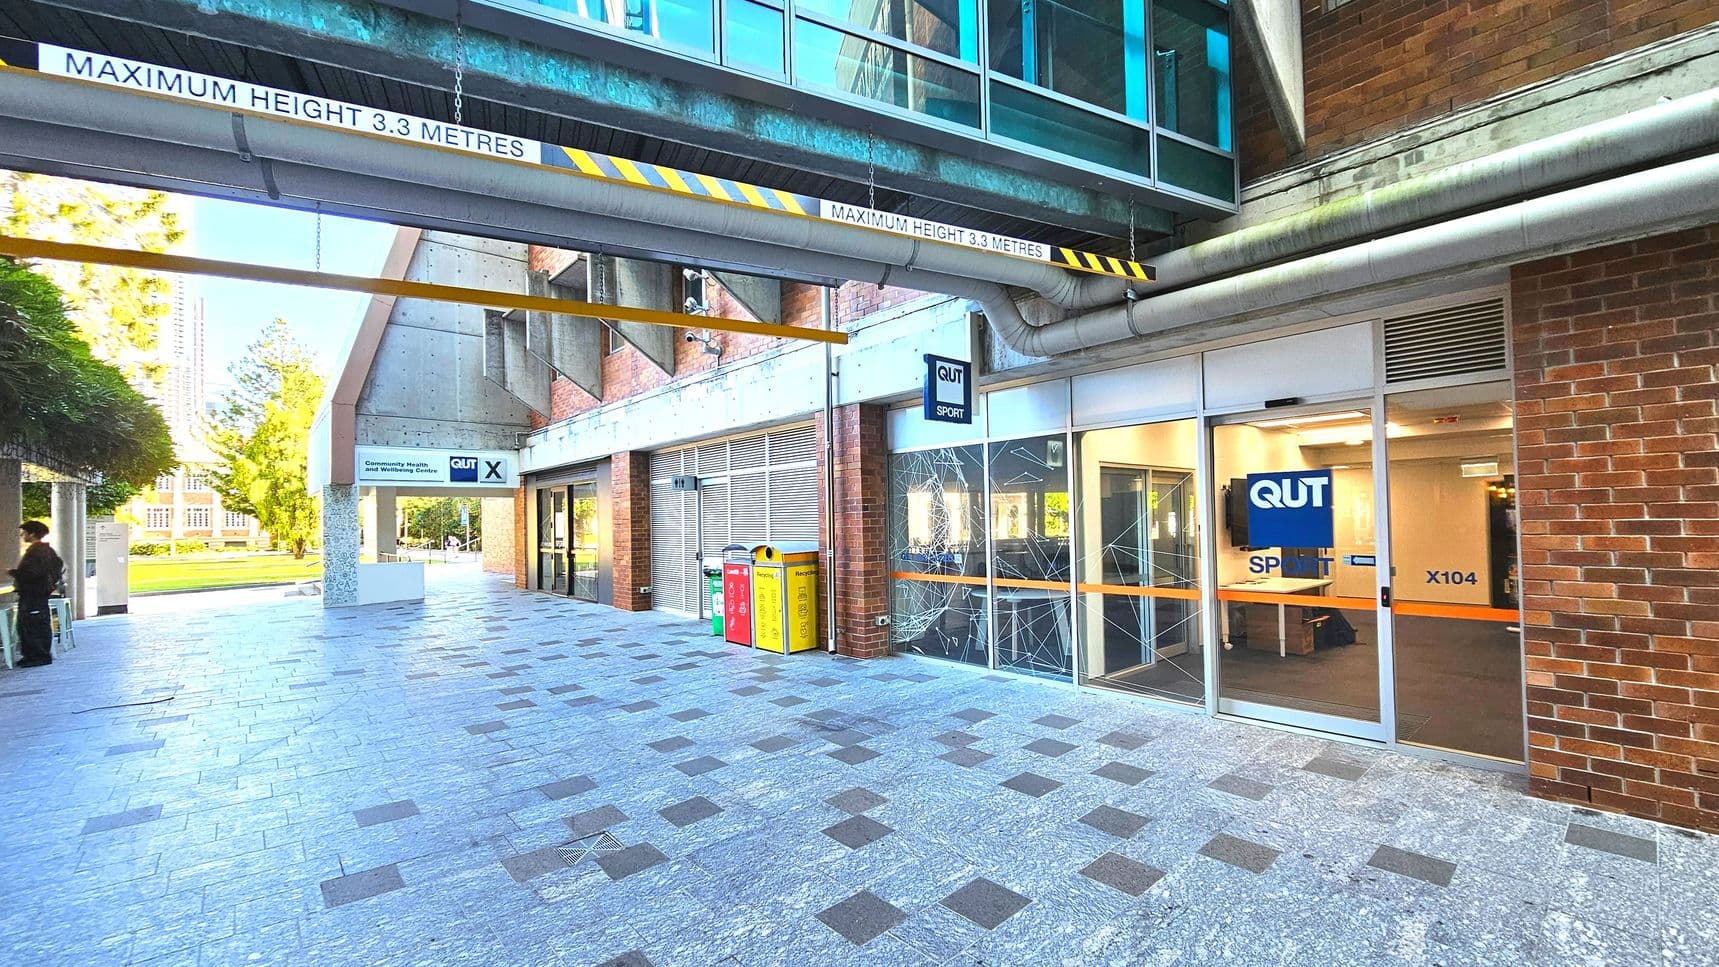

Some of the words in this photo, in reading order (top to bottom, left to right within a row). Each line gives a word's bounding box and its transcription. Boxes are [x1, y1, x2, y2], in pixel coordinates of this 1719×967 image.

[65, 52, 237, 104] MAXIMUM
[250, 87, 362, 127] HEIGHT
[372, 112, 411, 136] 3.3
[421, 121, 524, 158] METRES
[831, 203, 908, 234] MAXIMUM
[912, 220, 964, 244] HEIGHT
[968, 232, 988, 248] 3.3
[991, 236, 1043, 258] METRES
[937, 365, 963, 384] QUT
[936, 405, 965, 419] SPORT
[365, 460, 405, 468] Community
[450, 458, 477, 470] QUT
[484, 460, 502, 480] X
[1249, 476, 1329, 509] QUT
[1248, 555, 1335, 576] SPORT
[1425, 569, 1478, 585] X104
